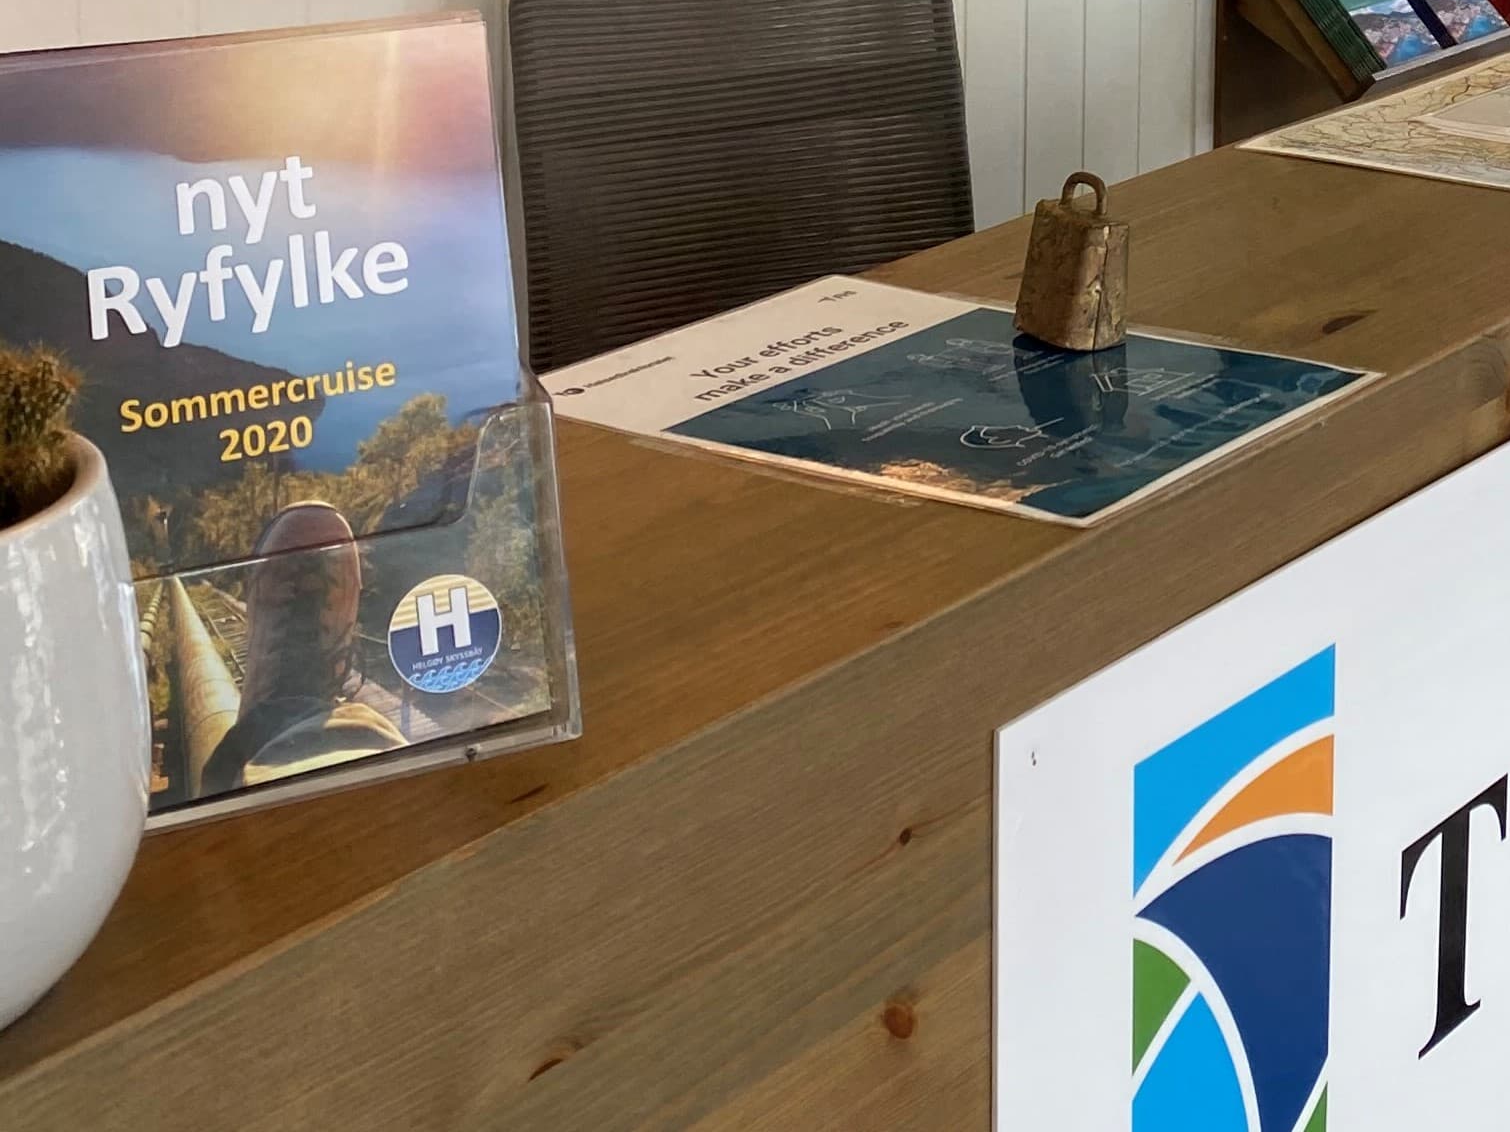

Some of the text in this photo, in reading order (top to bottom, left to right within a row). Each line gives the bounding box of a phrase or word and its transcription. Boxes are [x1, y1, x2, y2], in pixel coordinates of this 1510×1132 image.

[176, 156, 316, 244] nyt
[87, 230, 409, 348] Ryfylke
[689, 355, 758, 380] Your
[759, 325, 843, 358] efforts
[694, 320, 909, 402] make a difference
[120, 361, 398, 433] Sommercruise
[219, 415, 313, 462] 2020
[417, 587, 471, 656] H
